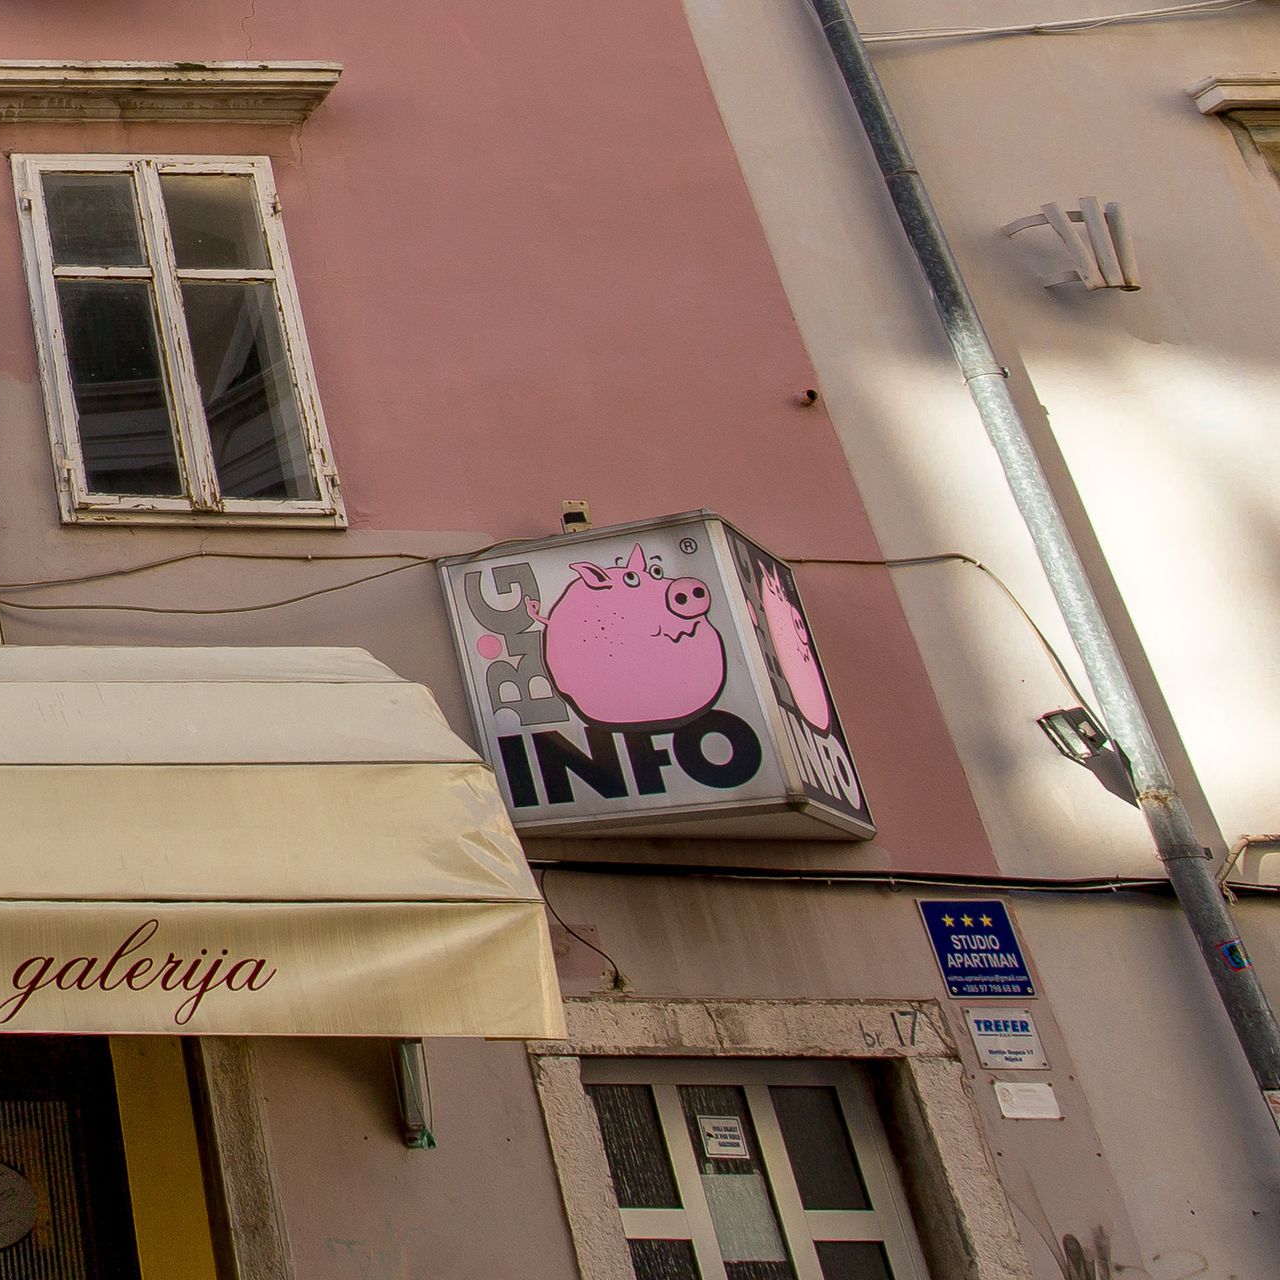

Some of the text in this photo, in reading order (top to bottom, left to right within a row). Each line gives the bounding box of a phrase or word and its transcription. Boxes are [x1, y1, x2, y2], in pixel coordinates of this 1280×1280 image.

[497, 708, 762, 809] INFO
[950, 934, 1000, 950] STUDIO
[947, 953, 1020, 968] APARTMAN
[890, 1010, 917, 1047] 17
[974, 1019, 1031, 1032] TREFER
